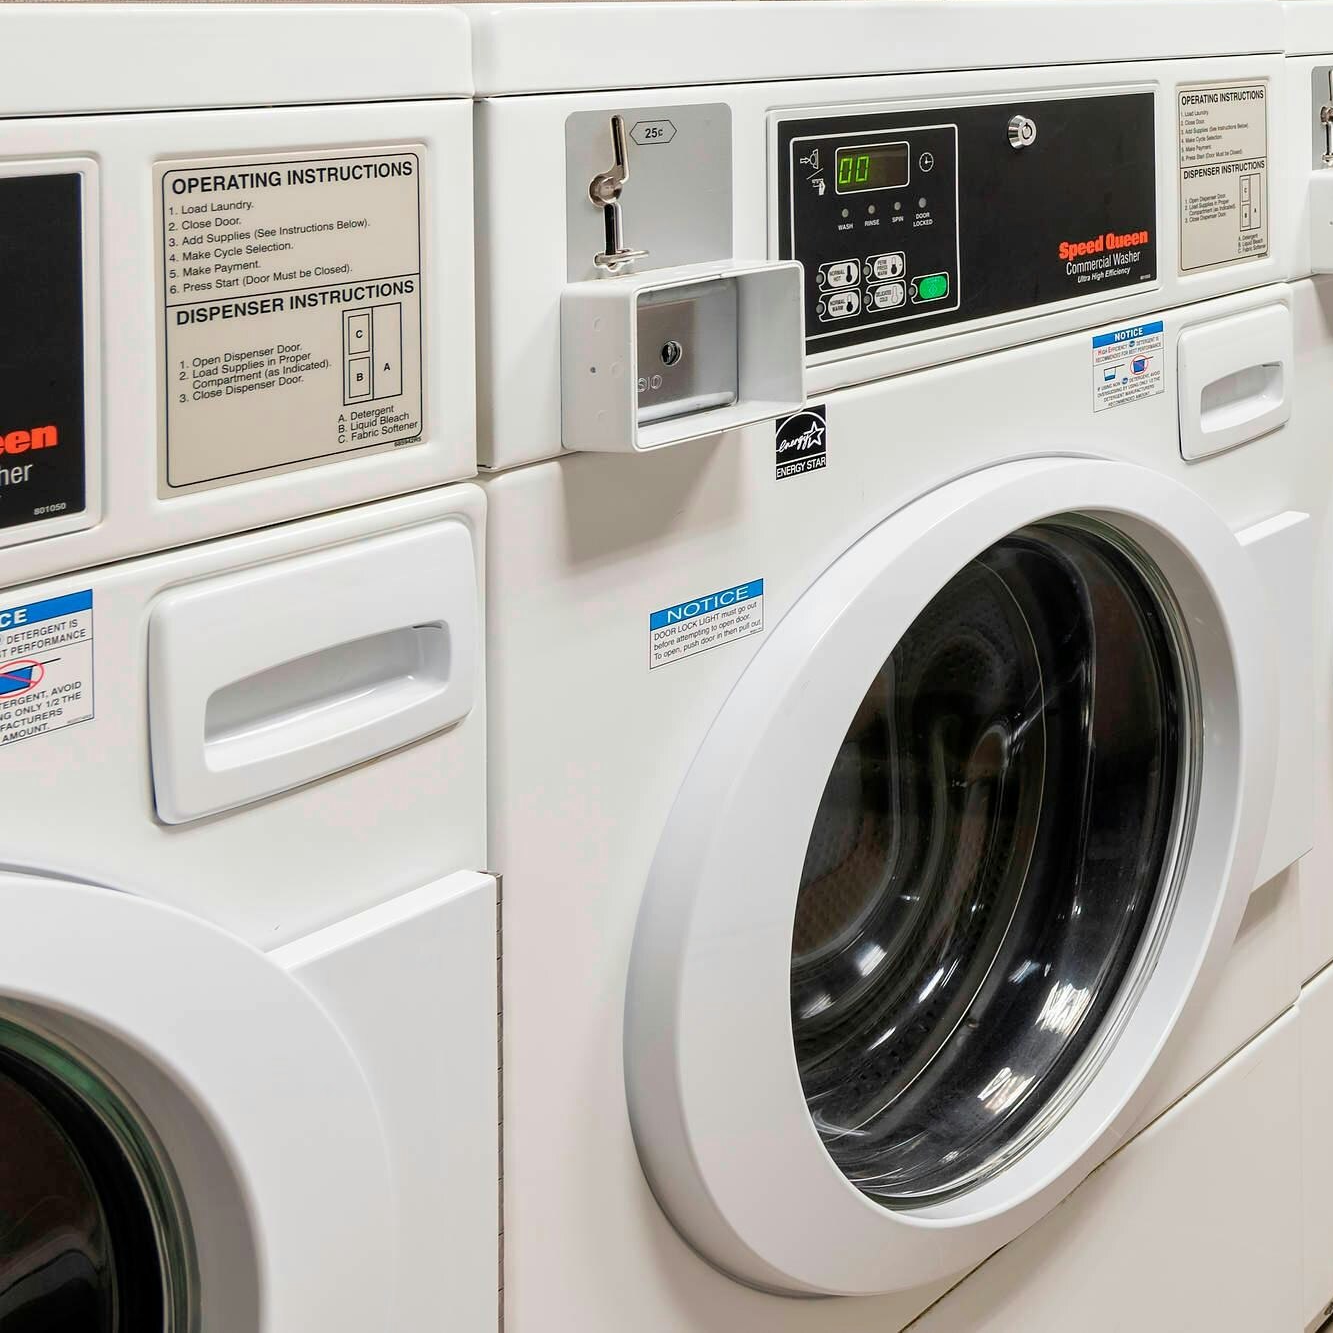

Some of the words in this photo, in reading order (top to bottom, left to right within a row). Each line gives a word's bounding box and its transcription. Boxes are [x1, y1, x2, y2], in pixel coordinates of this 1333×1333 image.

[1182, 94, 1218, 105] OPERATING
[1220, 90, 1263, 102] INSTRUCTIONS
[172, 172, 281, 194] OPERATING
[288, 162, 412, 185] INSTRUCTIONS
[1184, 168, 1220, 179] DISPENSER
[1222, 161, 1264, 174] INSTRUCTIONS
[170, 207, 178, 215] 1.
[182, 204, 207, 214] Load
[211, 200, 254, 212] Laundry.
[169, 223, 178, 231] 2.
[182, 220, 211, 230] Close
[215, 217, 241, 227] Door.
[169, 238, 178, 247] 3.
[182, 236, 203, 246] Add
[207, 231, 250, 244] Supplies
[255, 229, 276, 239] (See
[280, 222, 334, 235] Instructions
[337, 218, 370, 230] Below).
[913, 219, 933, 227] LOCKED
[170, 254, 179, 262] 4.
[183, 252, 210, 261] Make
[214, 247, 242, 259] Cycle
[246, 242, 294, 254] Selection.
[1059, 235, 1103, 260] Speed
[1106, 231, 1148, 250] Queen
[170, 270, 179, 278] 5.
[183, 266, 211, 277] Make
[215, 261, 261, 273] Payment.
[1066, 254, 1111, 275] Commercial
[1113, 251, 1140, 265] Washer
[170, 286, 179, 294] 6.
[184, 281, 212, 292] Press
[216, 278, 239, 288] Start
[243, 275, 270, 286] (Door
[274, 271, 296, 281] Must
[300, 269, 311, 278] be
[314, 264, 352, 276] Closed).
[1078, 275, 1090, 283] Ultra
[1092, 272, 1104, 281] High
[1105, 267, 1130, 278] Efficiency
[177, 298, 283, 325] DISPENSER
[291, 280, 414, 309] INSTRUCTIONS
[356, 330, 363, 338] C
[1115, 327, 1143, 341] NOTICE
[179, 372, 189, 380] 2.
[193, 367, 218, 379] Load
[222, 360, 264, 375] Supplies
[268, 356, 276, 365] in
[280, 352, 311, 365] Proper
[180, 361, 189, 369] 1.
[192, 356, 220, 369] Open
[224, 348, 274, 365] Dispenser
[278, 343, 302, 354] Door.
[384, 363, 390, 371] A
[193, 371, 261, 390] Compartment
[265, 368, 279, 379] (as
[283, 359, 331, 374] Indicated).
[357, 373, 364, 381] B
[179, 394, 189, 403] 3.
[193, 390, 222, 401] Close
[226, 380, 275, 396] Dispenser
[279, 376, 304, 386] Door.
[338, 414, 347, 422] A.
[351, 405, 394, 421] Detergent
[338, 424, 347, 433] B.
[351, 419, 377, 431] Liquid
[380, 412, 409, 425] Bleach
[0, 426, 57, 455] en
[338, 435, 348, 444] C.
[352, 429, 379, 441] Fabric
[382, 421, 418, 435] Softener
[777, 462, 805, 477] ENERGY
[807, 457, 825, 469] STAR
[668, 586, 748, 622] NOTICE
[7, 622, 66, 644] DETERGENT
[69, 619, 77, 628] IS
[655, 628, 676, 641] DOOR
[678, 621, 698, 634] LOCK
[699, 613, 719, 625] LIGHT
[722, 608, 736, 617] must
[738, 606, 745, 614] go
[747, 602, 757, 610] out
[11, 629, 86, 655] PERFORMANCE
[654, 638, 674, 651] before
[677, 628, 709, 643] attempting
[719, 620, 735, 629] open
[664, 647, 682, 657] open,
[684, 639, 699, 652] push
[701, 634, 715, 645] door
[724, 627, 737, 636] then
[739, 623, 750, 633] pull
[51, 682, 81, 695] AVOID
[15, 703, 41, 716] ONLY
[47, 698, 59, 707] 1/2
[62, 691, 81, 703] THE
[2, 723, 49, 742] AMOUNT.
